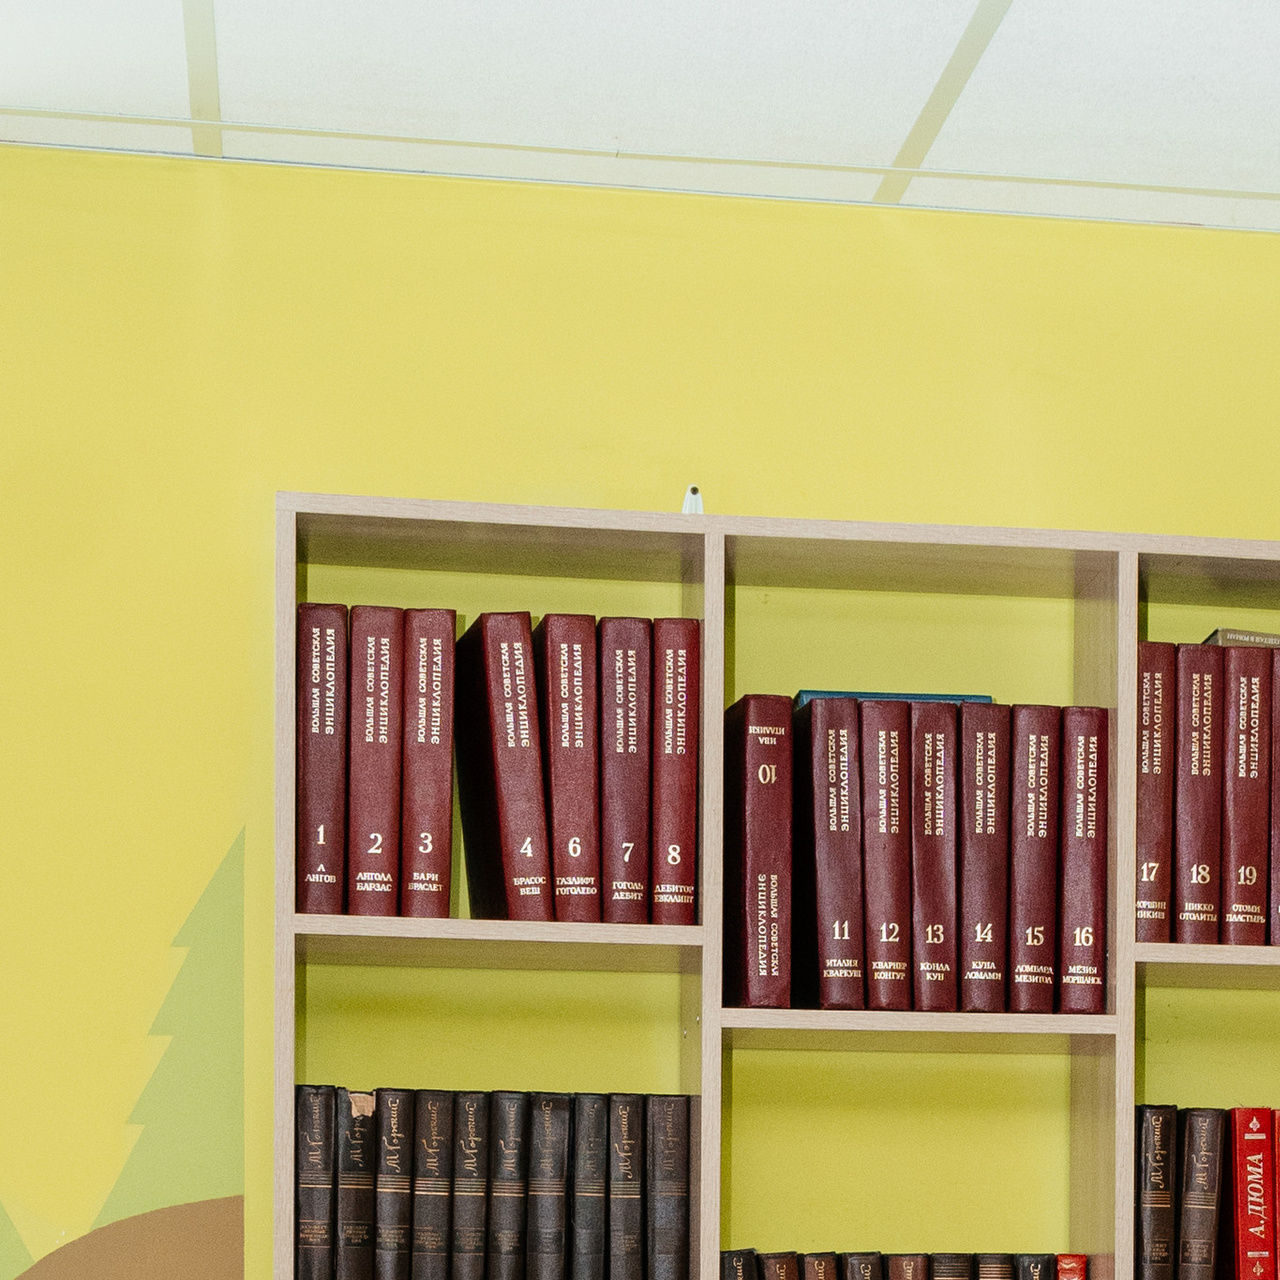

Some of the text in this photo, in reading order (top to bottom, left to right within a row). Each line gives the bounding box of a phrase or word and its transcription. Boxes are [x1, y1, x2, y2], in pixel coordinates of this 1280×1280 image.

[312, 628, 320, 683] СОВЕТСКАЯ
[325, 629, 335, 734] ЭНЦИКЛОПЕДИЯ
[366, 637, 375, 742] БОЛЬШАЯ СОВЕТСКАЯ
[379, 638, 389, 743] ЭНЦИКЛОПЕДИЯ
[1239, 677, 1247, 730] СОВЕТСКАЯ
[1250, 677, 1259, 778] ЭНЦИКЛОПЕДИЯ
[758, 765, 776, 783] 10
[840, 729, 849, 831] ЭНЦИКЛОПЕДИЯ
[829, 788, 837, 831] БОЛЬШАЯ
[318, 825, 324, 844] 1
[368, 833, 382, 853] 2
[419, 832, 432, 853] 3
[520, 837, 532, 857] 4
[569, 837, 581, 857] 6
[621, 842, 634, 862] 7
[667, 845, 680, 865] 8
[1141, 862, 1158, 881] 17
[1190, 864, 1209, 883] 18
[1238, 866, 1256, 885] 19
[833, 921, 849, 939] 11
[880, 922, 899, 942] 12
[926, 925, 944, 943] 13
[975, 923, 992, 942] 14
[1026, 927, 1043, 945] 15
[1074, 927, 1093, 946] 16
[1249, 1152, 1266, 1238] А.ДЮМА
